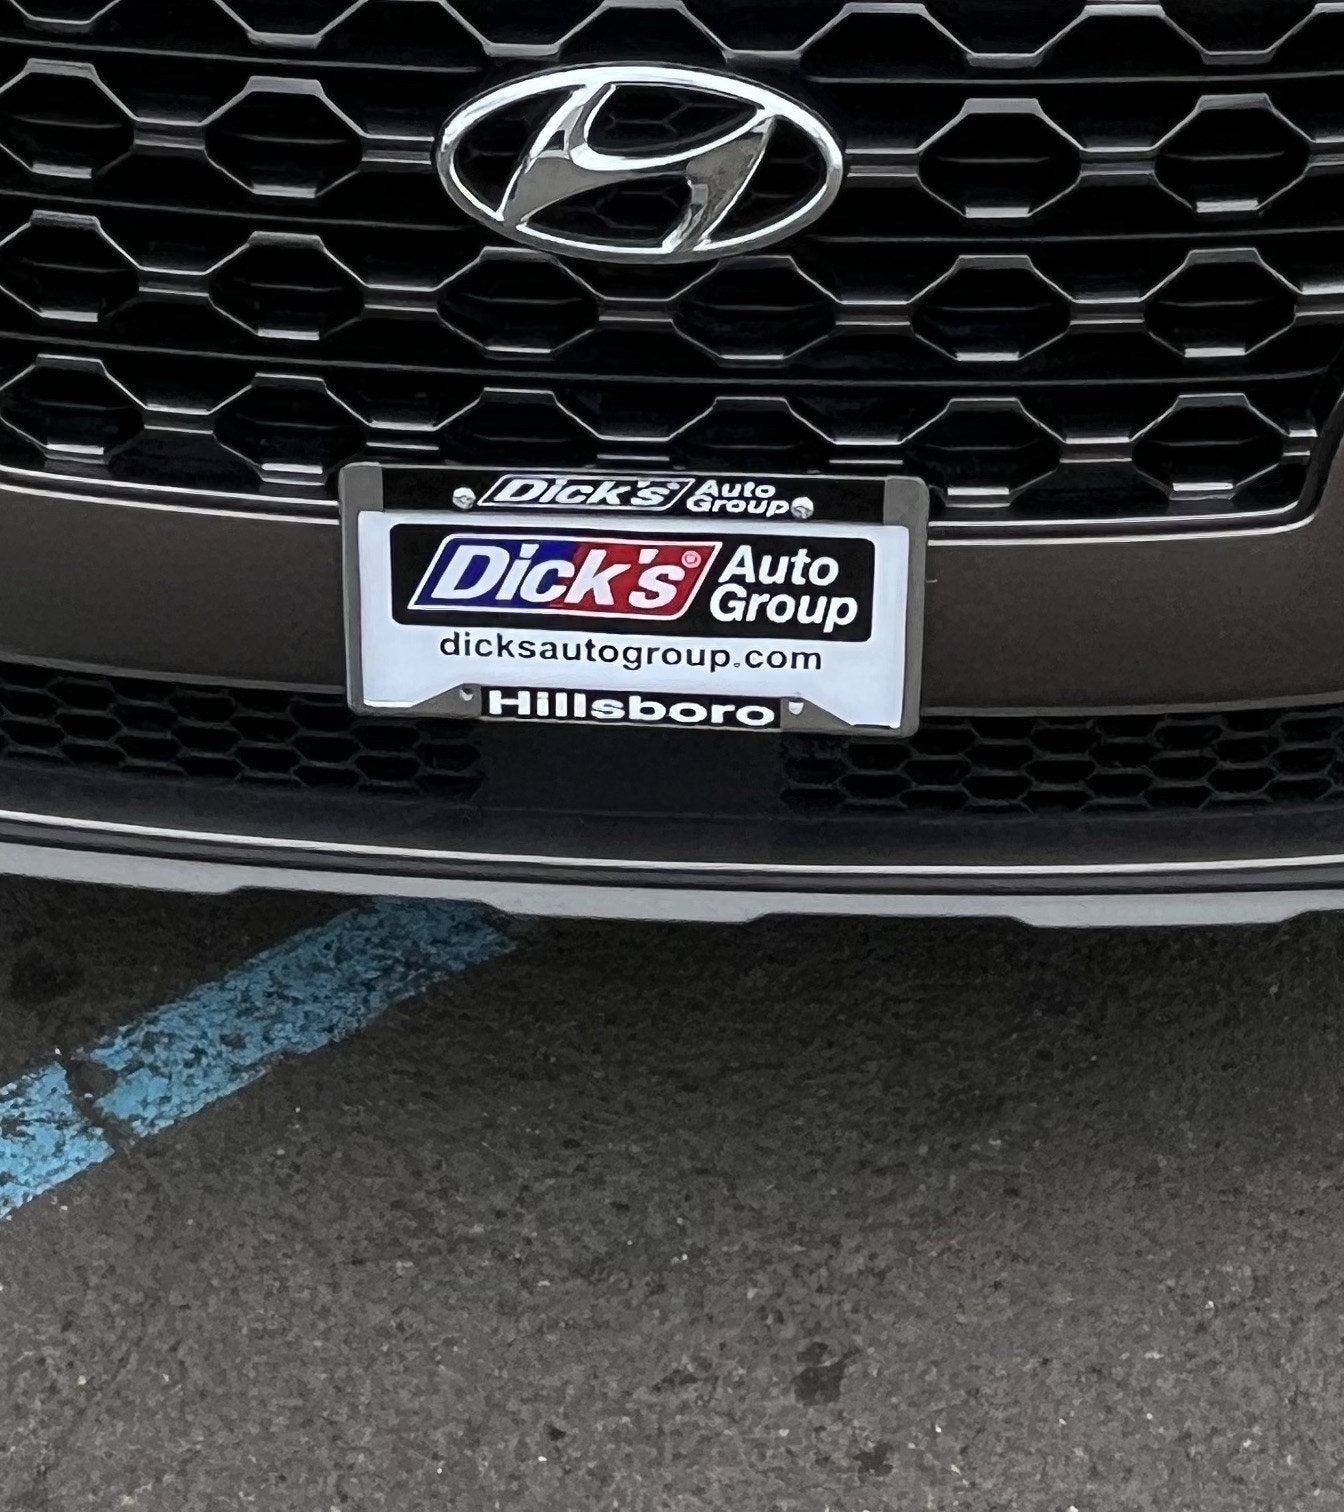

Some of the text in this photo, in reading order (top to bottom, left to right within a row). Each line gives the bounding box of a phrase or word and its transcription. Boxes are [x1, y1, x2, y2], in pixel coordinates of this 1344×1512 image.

[686, 495, 791, 517] Group
[699, 479, 777, 498] Auto
[718, 544, 840, 587] Auto
[709, 584, 858, 634] Group
[439, 632, 823, 671] dicksautogroup.com
[488, 690, 775, 727] Hillsboro
